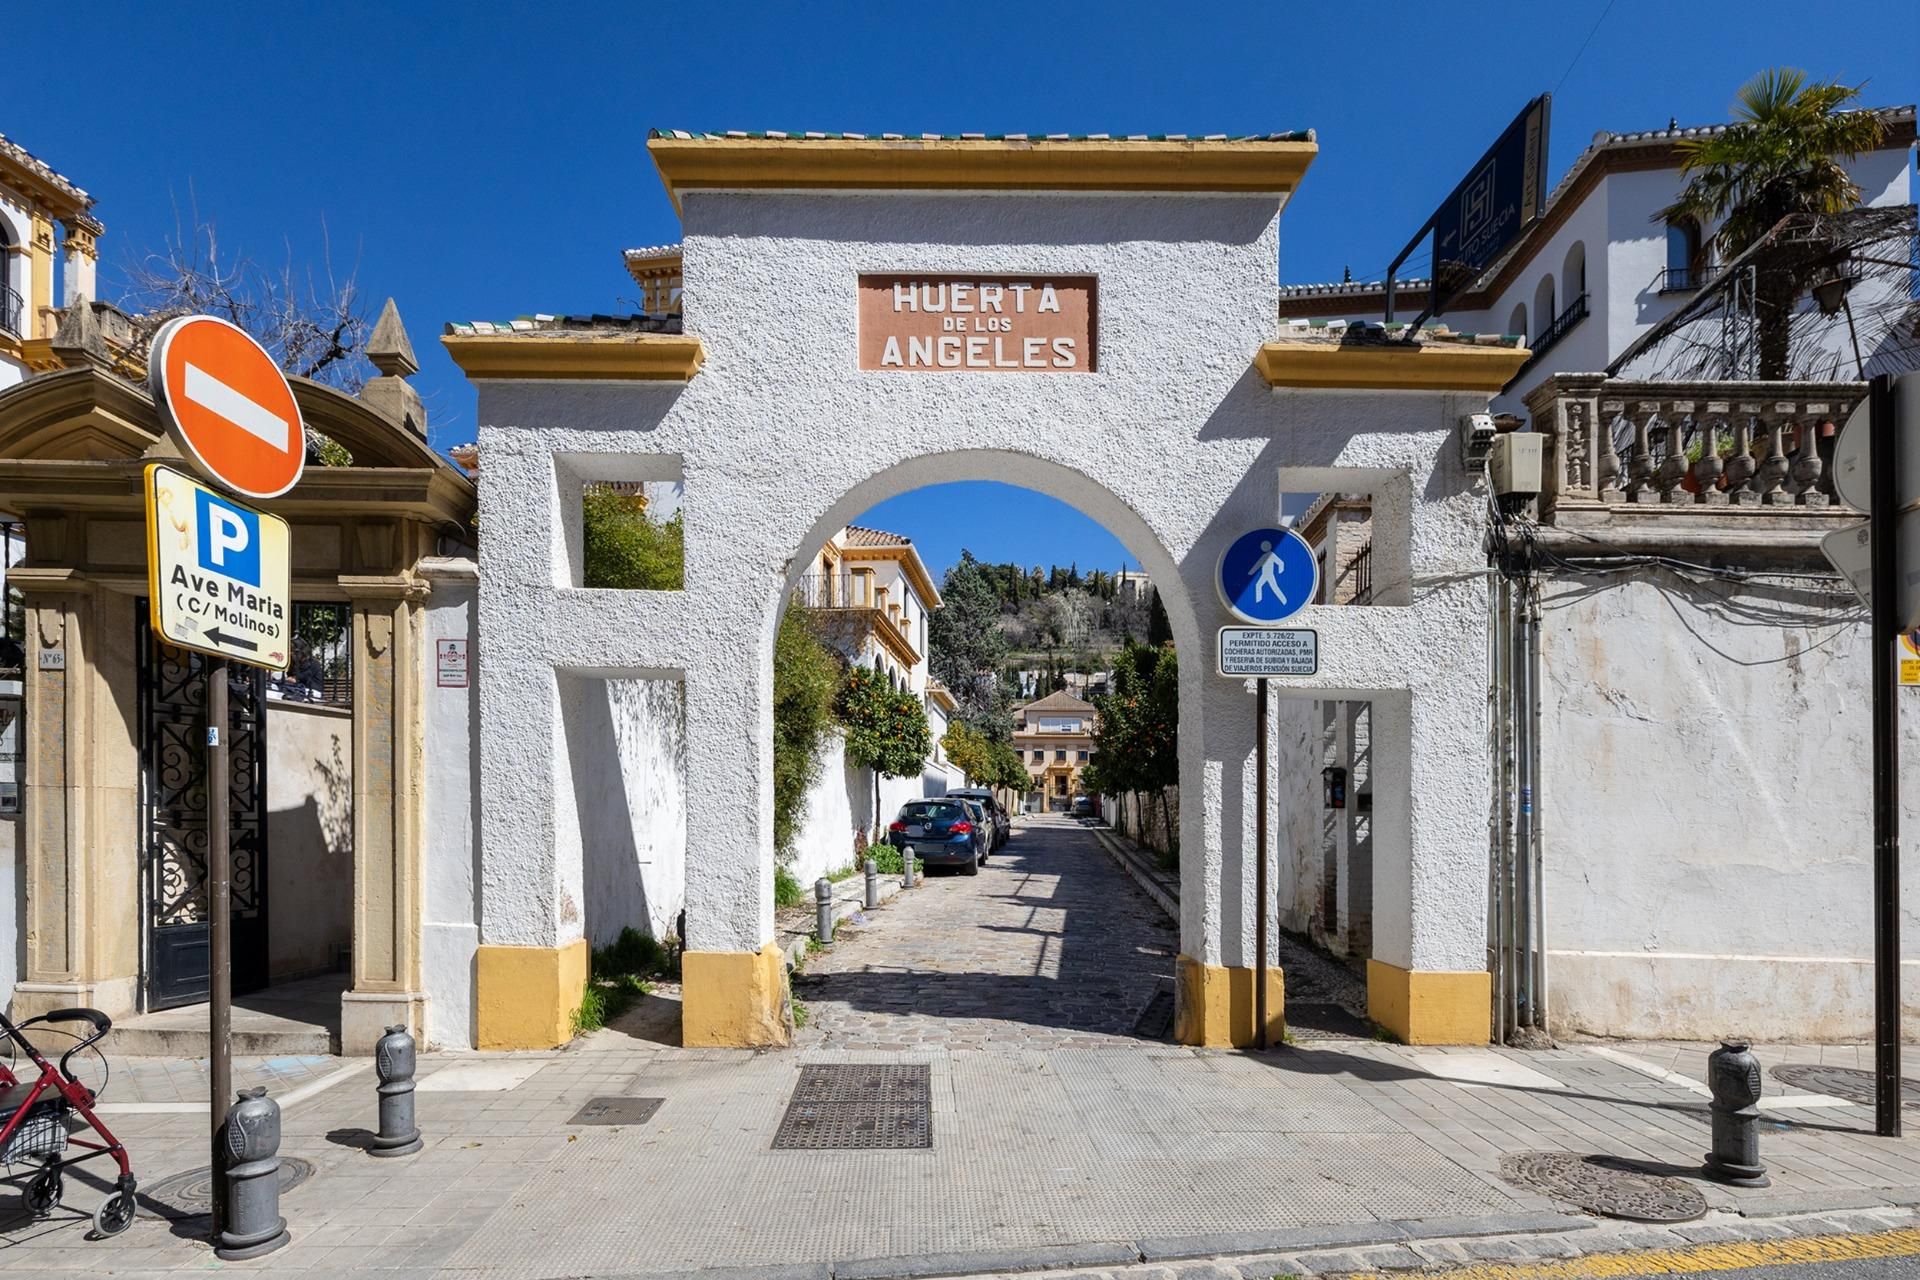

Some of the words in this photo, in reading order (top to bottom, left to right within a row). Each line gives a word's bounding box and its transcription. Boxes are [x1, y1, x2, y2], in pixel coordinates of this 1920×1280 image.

[1482, 202, 1515, 245] SUECIA
[893, 282, 1060, 313] HUERTA
[943, 317, 967, 332] DE
[974, 317, 1012, 332] LOS
[881, 336, 1076, 368] ANGELES
[208, 502, 249, 567] P
[170, 564, 219, 598] Ave
[228, 582, 283, 620] Maria
[1272, 640, 1300, 648] ACCESO
[1263, 664, 1290, 672] PENSIÓN
